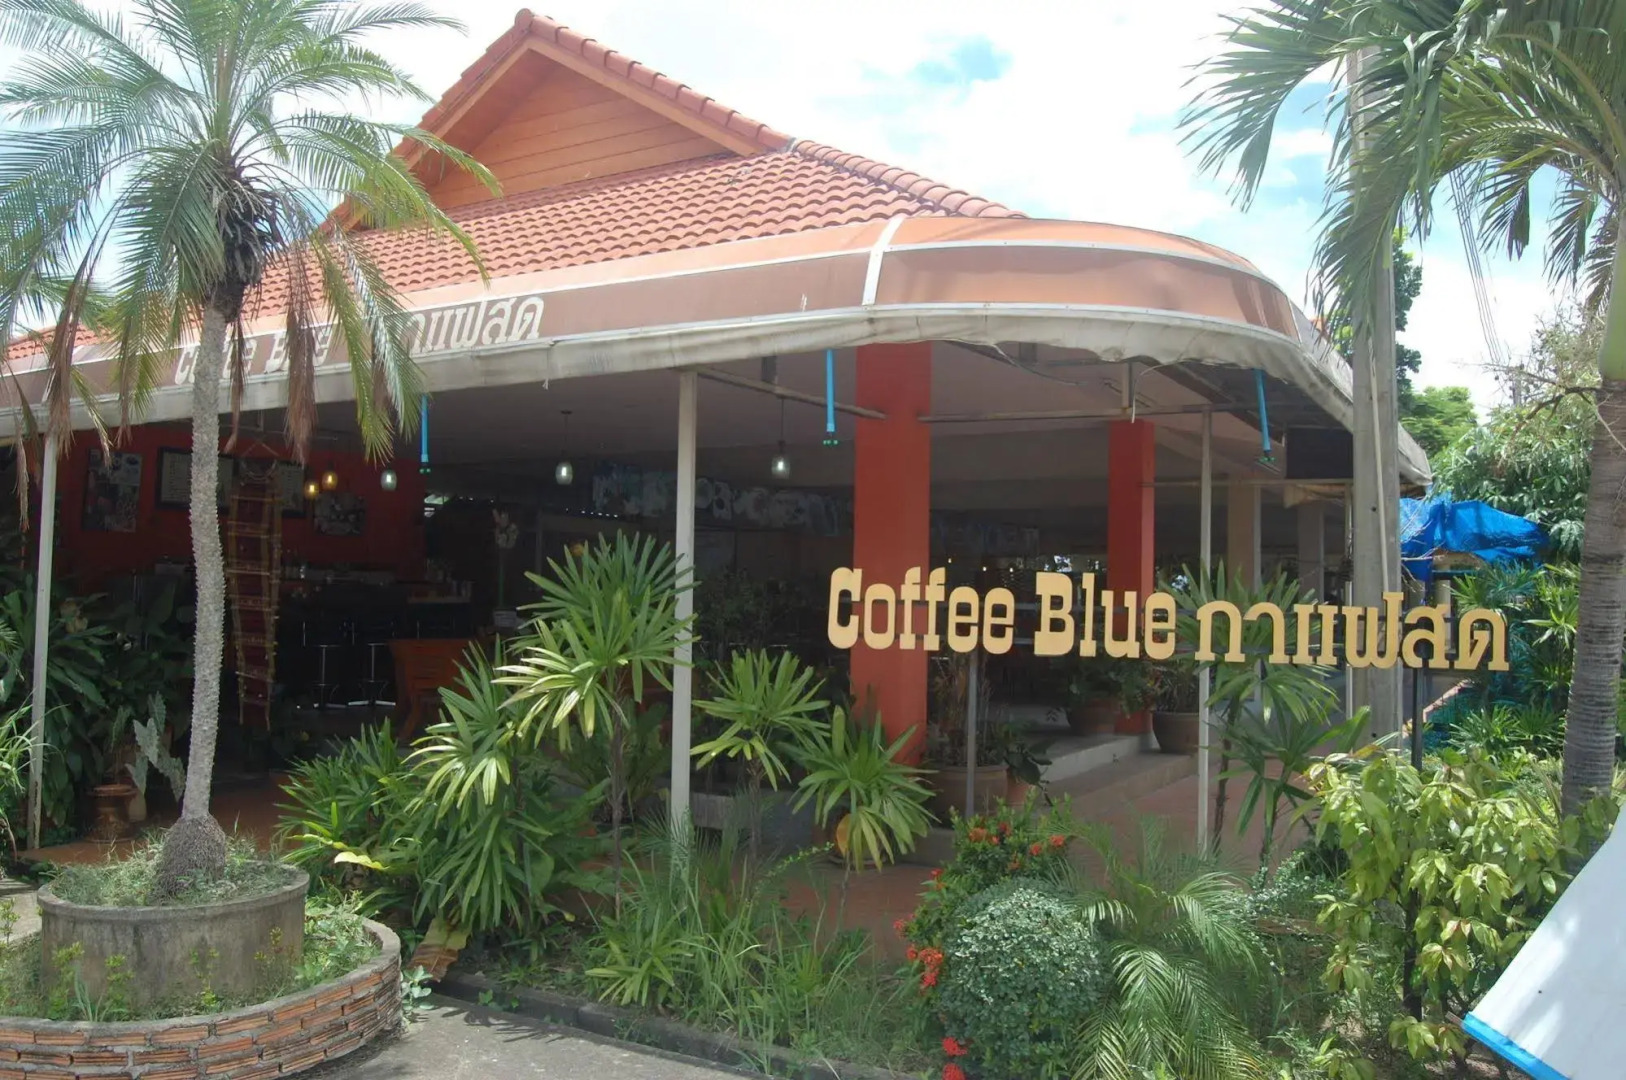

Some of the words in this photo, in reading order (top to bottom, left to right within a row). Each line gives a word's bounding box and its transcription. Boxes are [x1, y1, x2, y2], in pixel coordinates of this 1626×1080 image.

[388, 297, 544, 353] าแฟสด
[828, 566, 1015, 654] Coffee
[1034, 571, 1176, 660] Blue
[1195, 591, 1509, 671] กาแฟสด
